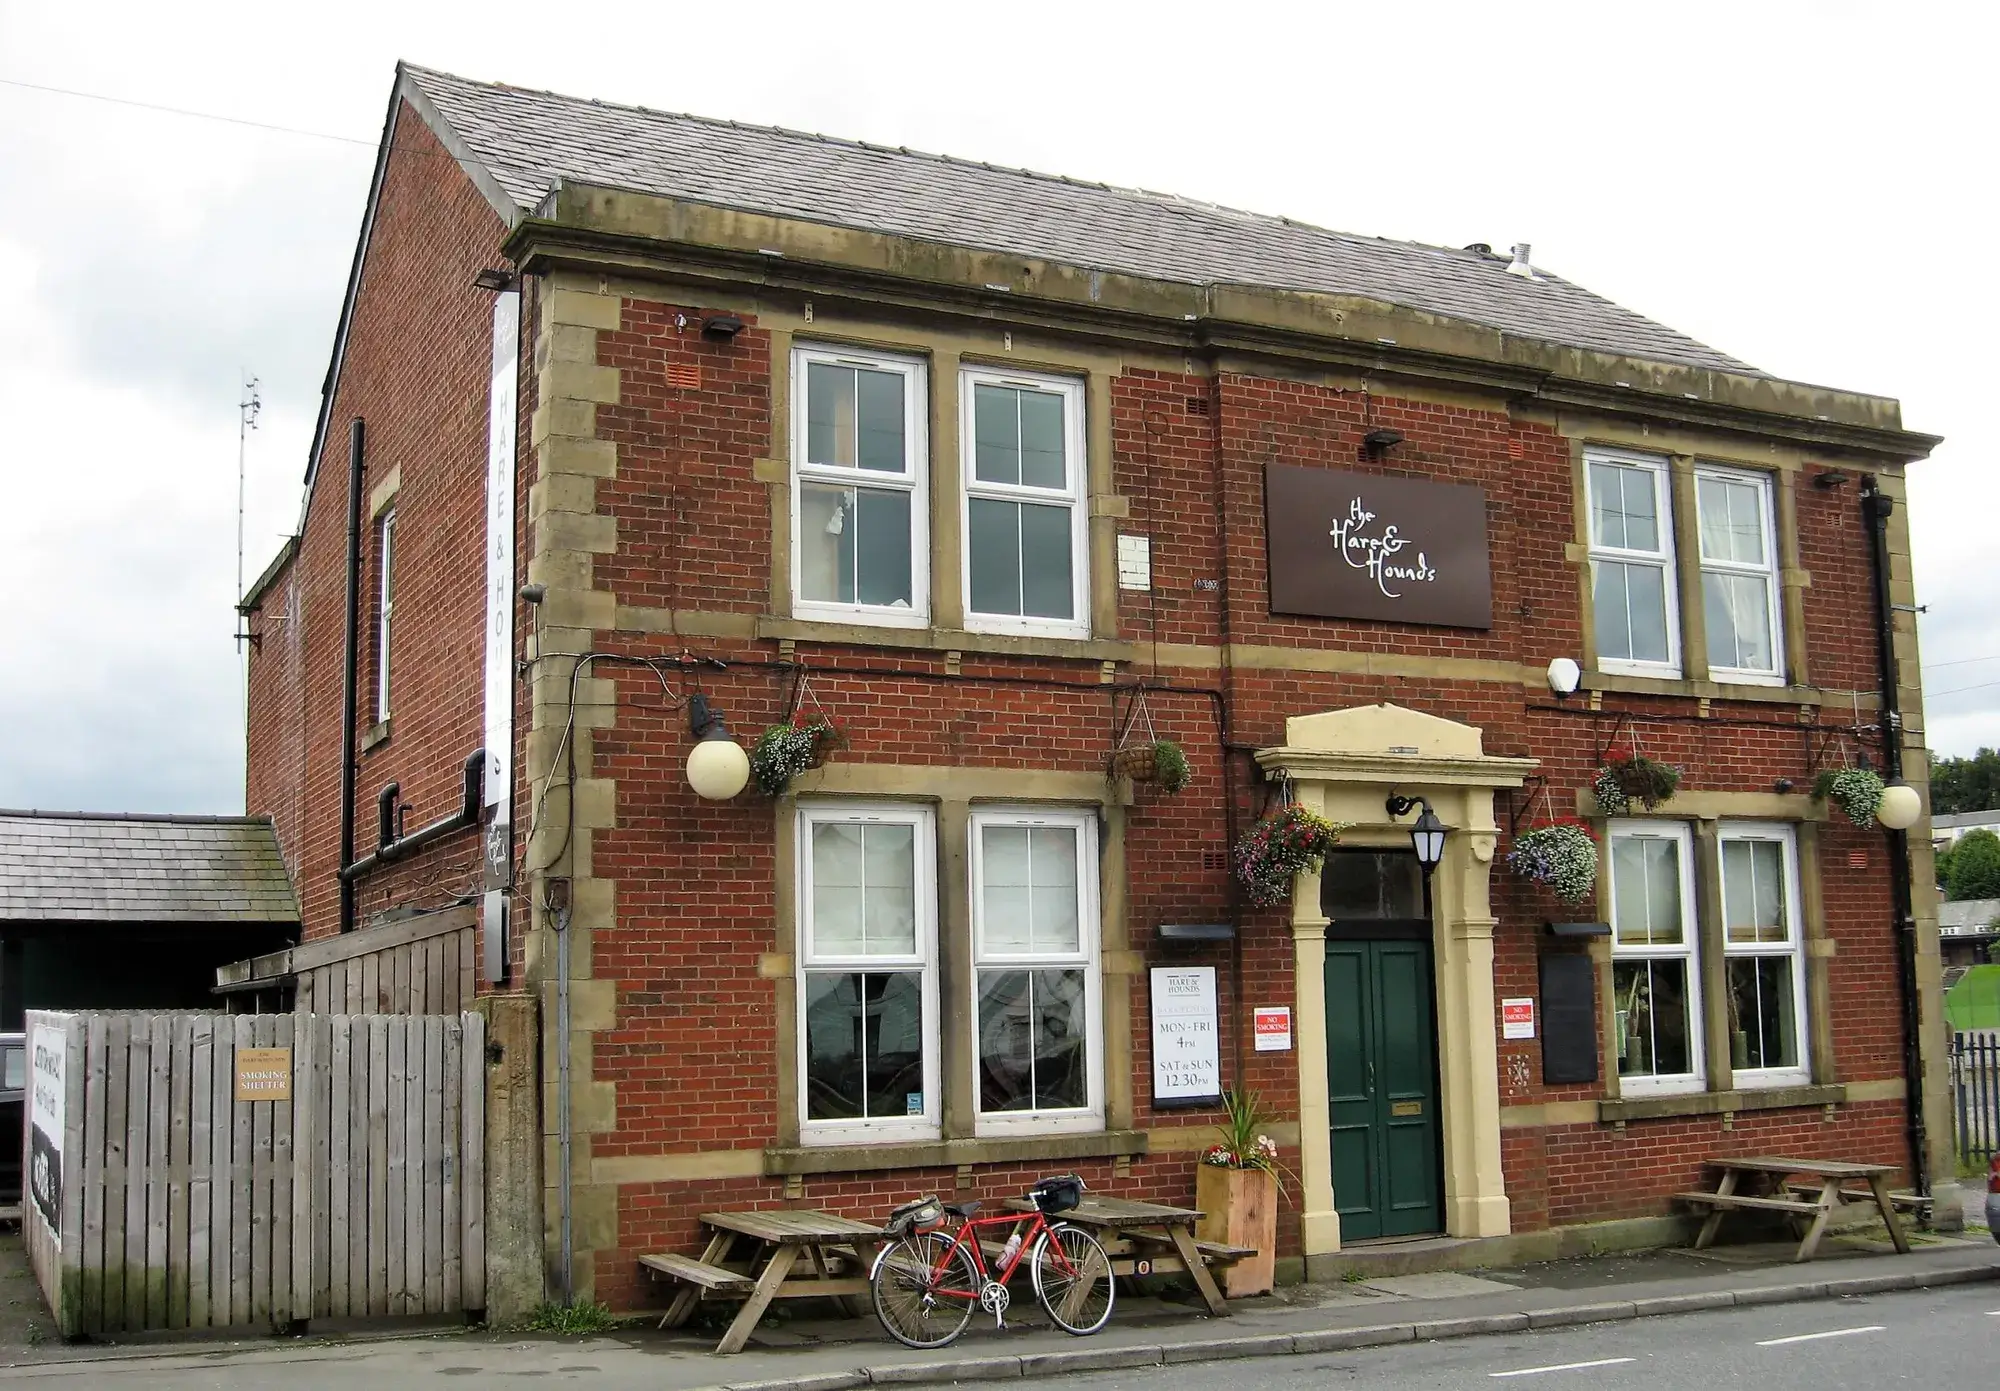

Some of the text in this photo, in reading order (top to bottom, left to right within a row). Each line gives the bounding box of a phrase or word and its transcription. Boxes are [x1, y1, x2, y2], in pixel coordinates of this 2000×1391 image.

[498, 390, 508, 518] HARE
[1350, 497, 1376, 532] the
[496, 533, 504, 560] &
[1330, 518, 1412, 568] Hare &
[1366, 549, 1436, 598] Hounds
[1160, 1023, 1186, 1032] MON
[1193, 1022, 1211, 1031] FRI
[1257, 1023, 1288, 1031] SMOKING
[1176, 1036, 1196, 1048] 4PM
[1160, 1061, 1180, 1071] SAT
[1190, 1060, 1212, 1070] SUN
[240, 1070, 287, 1079] SMOKING
[241, 1081, 286, 1089] SHELTER
